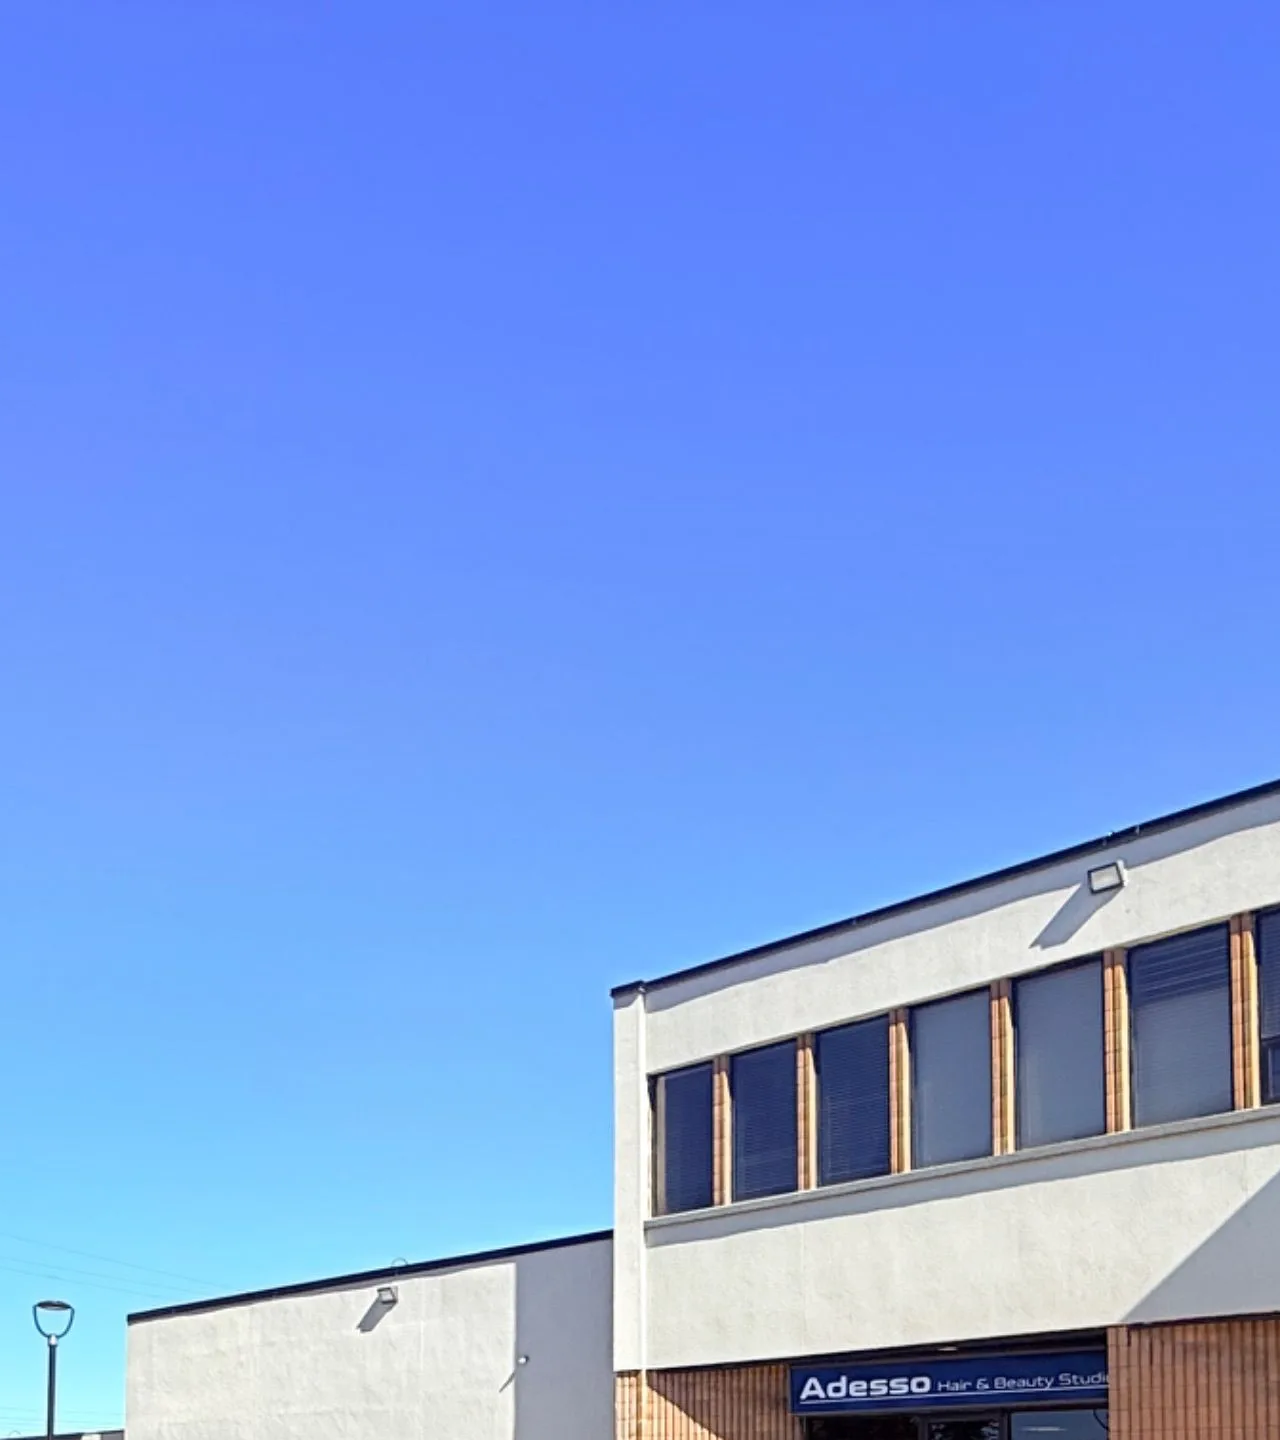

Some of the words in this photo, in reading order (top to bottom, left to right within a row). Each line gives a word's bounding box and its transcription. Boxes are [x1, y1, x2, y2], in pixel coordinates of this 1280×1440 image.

[800, 1376, 931, 1400] Adesso
[937, 1379, 972, 1392] Hair
[976, 1378, 990, 1390] &
[994, 1375, 1054, 1390] Beauty
